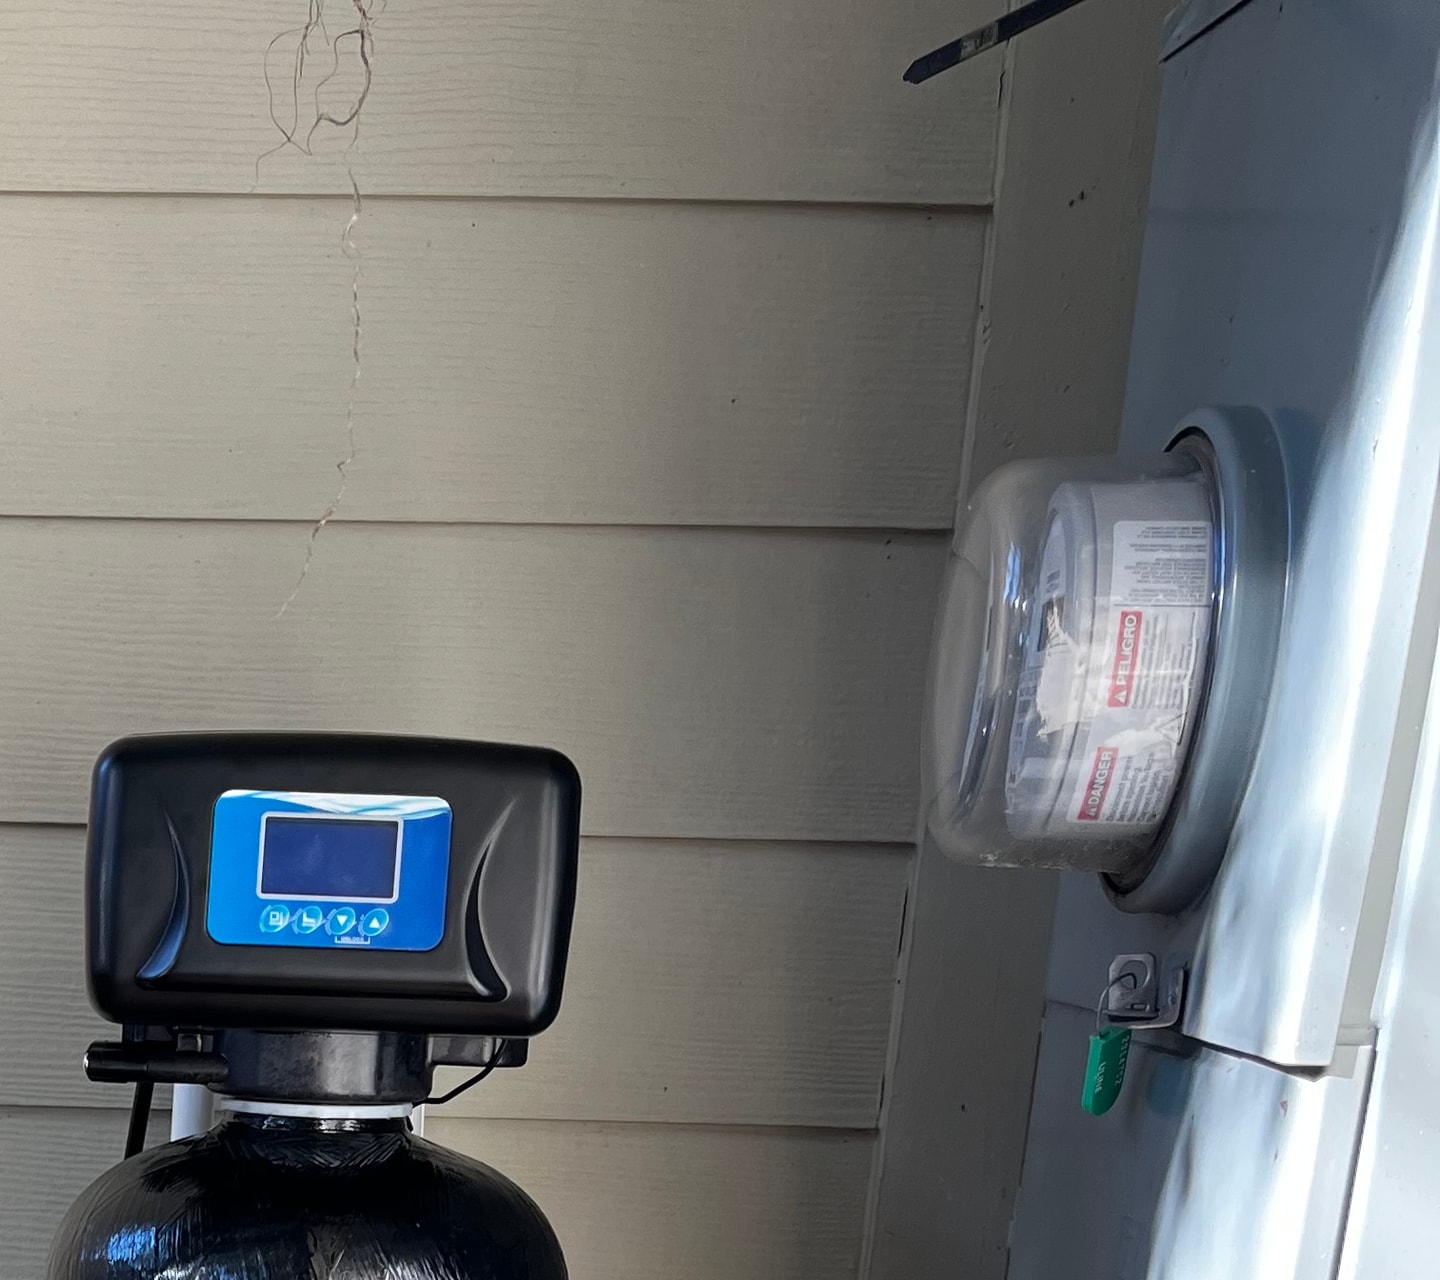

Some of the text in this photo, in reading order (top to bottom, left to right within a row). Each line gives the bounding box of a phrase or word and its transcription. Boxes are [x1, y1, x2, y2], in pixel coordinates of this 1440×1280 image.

[1116, 614, 1137, 686] PELIGRO
[1090, 751, 1113, 805] DANGER
[1095, 1062, 1107, 1094] ULINE
